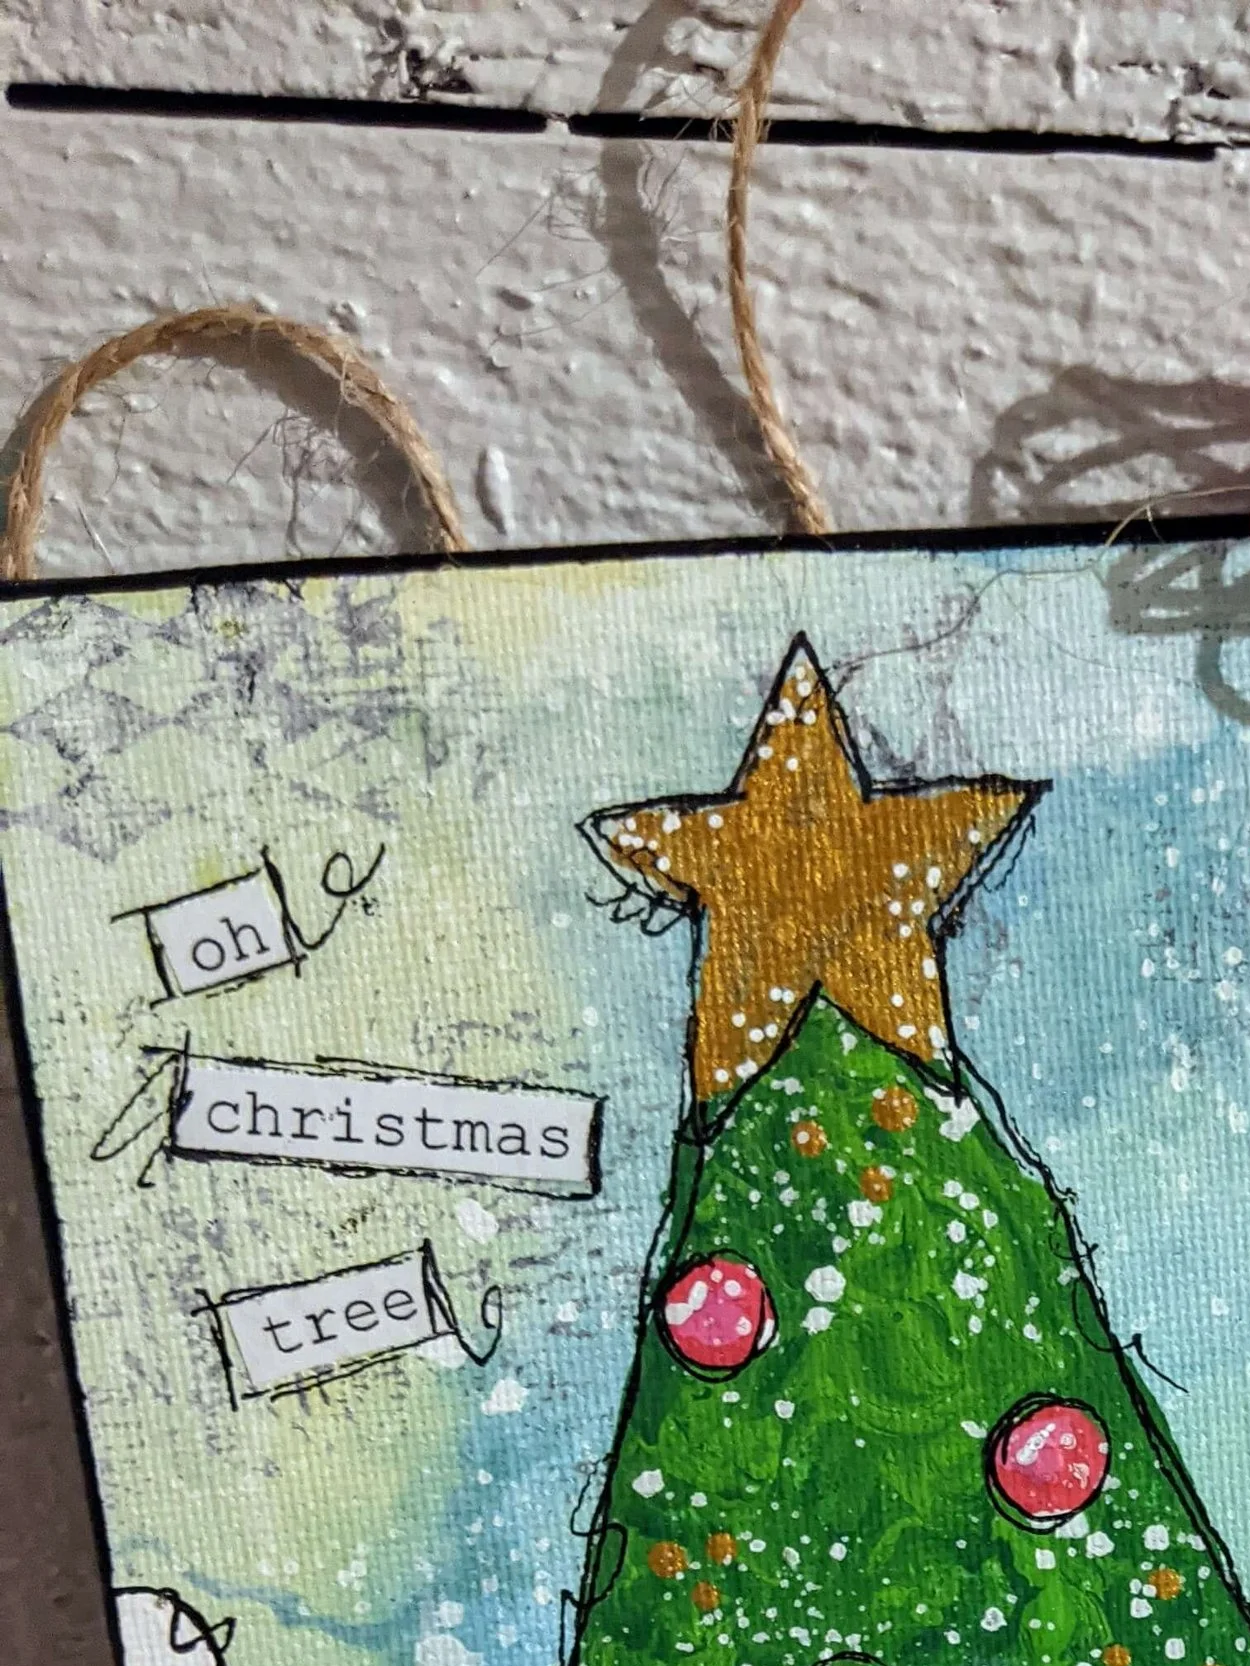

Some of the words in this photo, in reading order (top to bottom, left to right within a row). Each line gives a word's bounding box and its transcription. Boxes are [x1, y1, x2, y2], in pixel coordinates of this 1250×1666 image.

[191, 917, 271, 972] oh
[206, 1091, 570, 1160] christmas
[262, 1287, 419, 1355] tree
